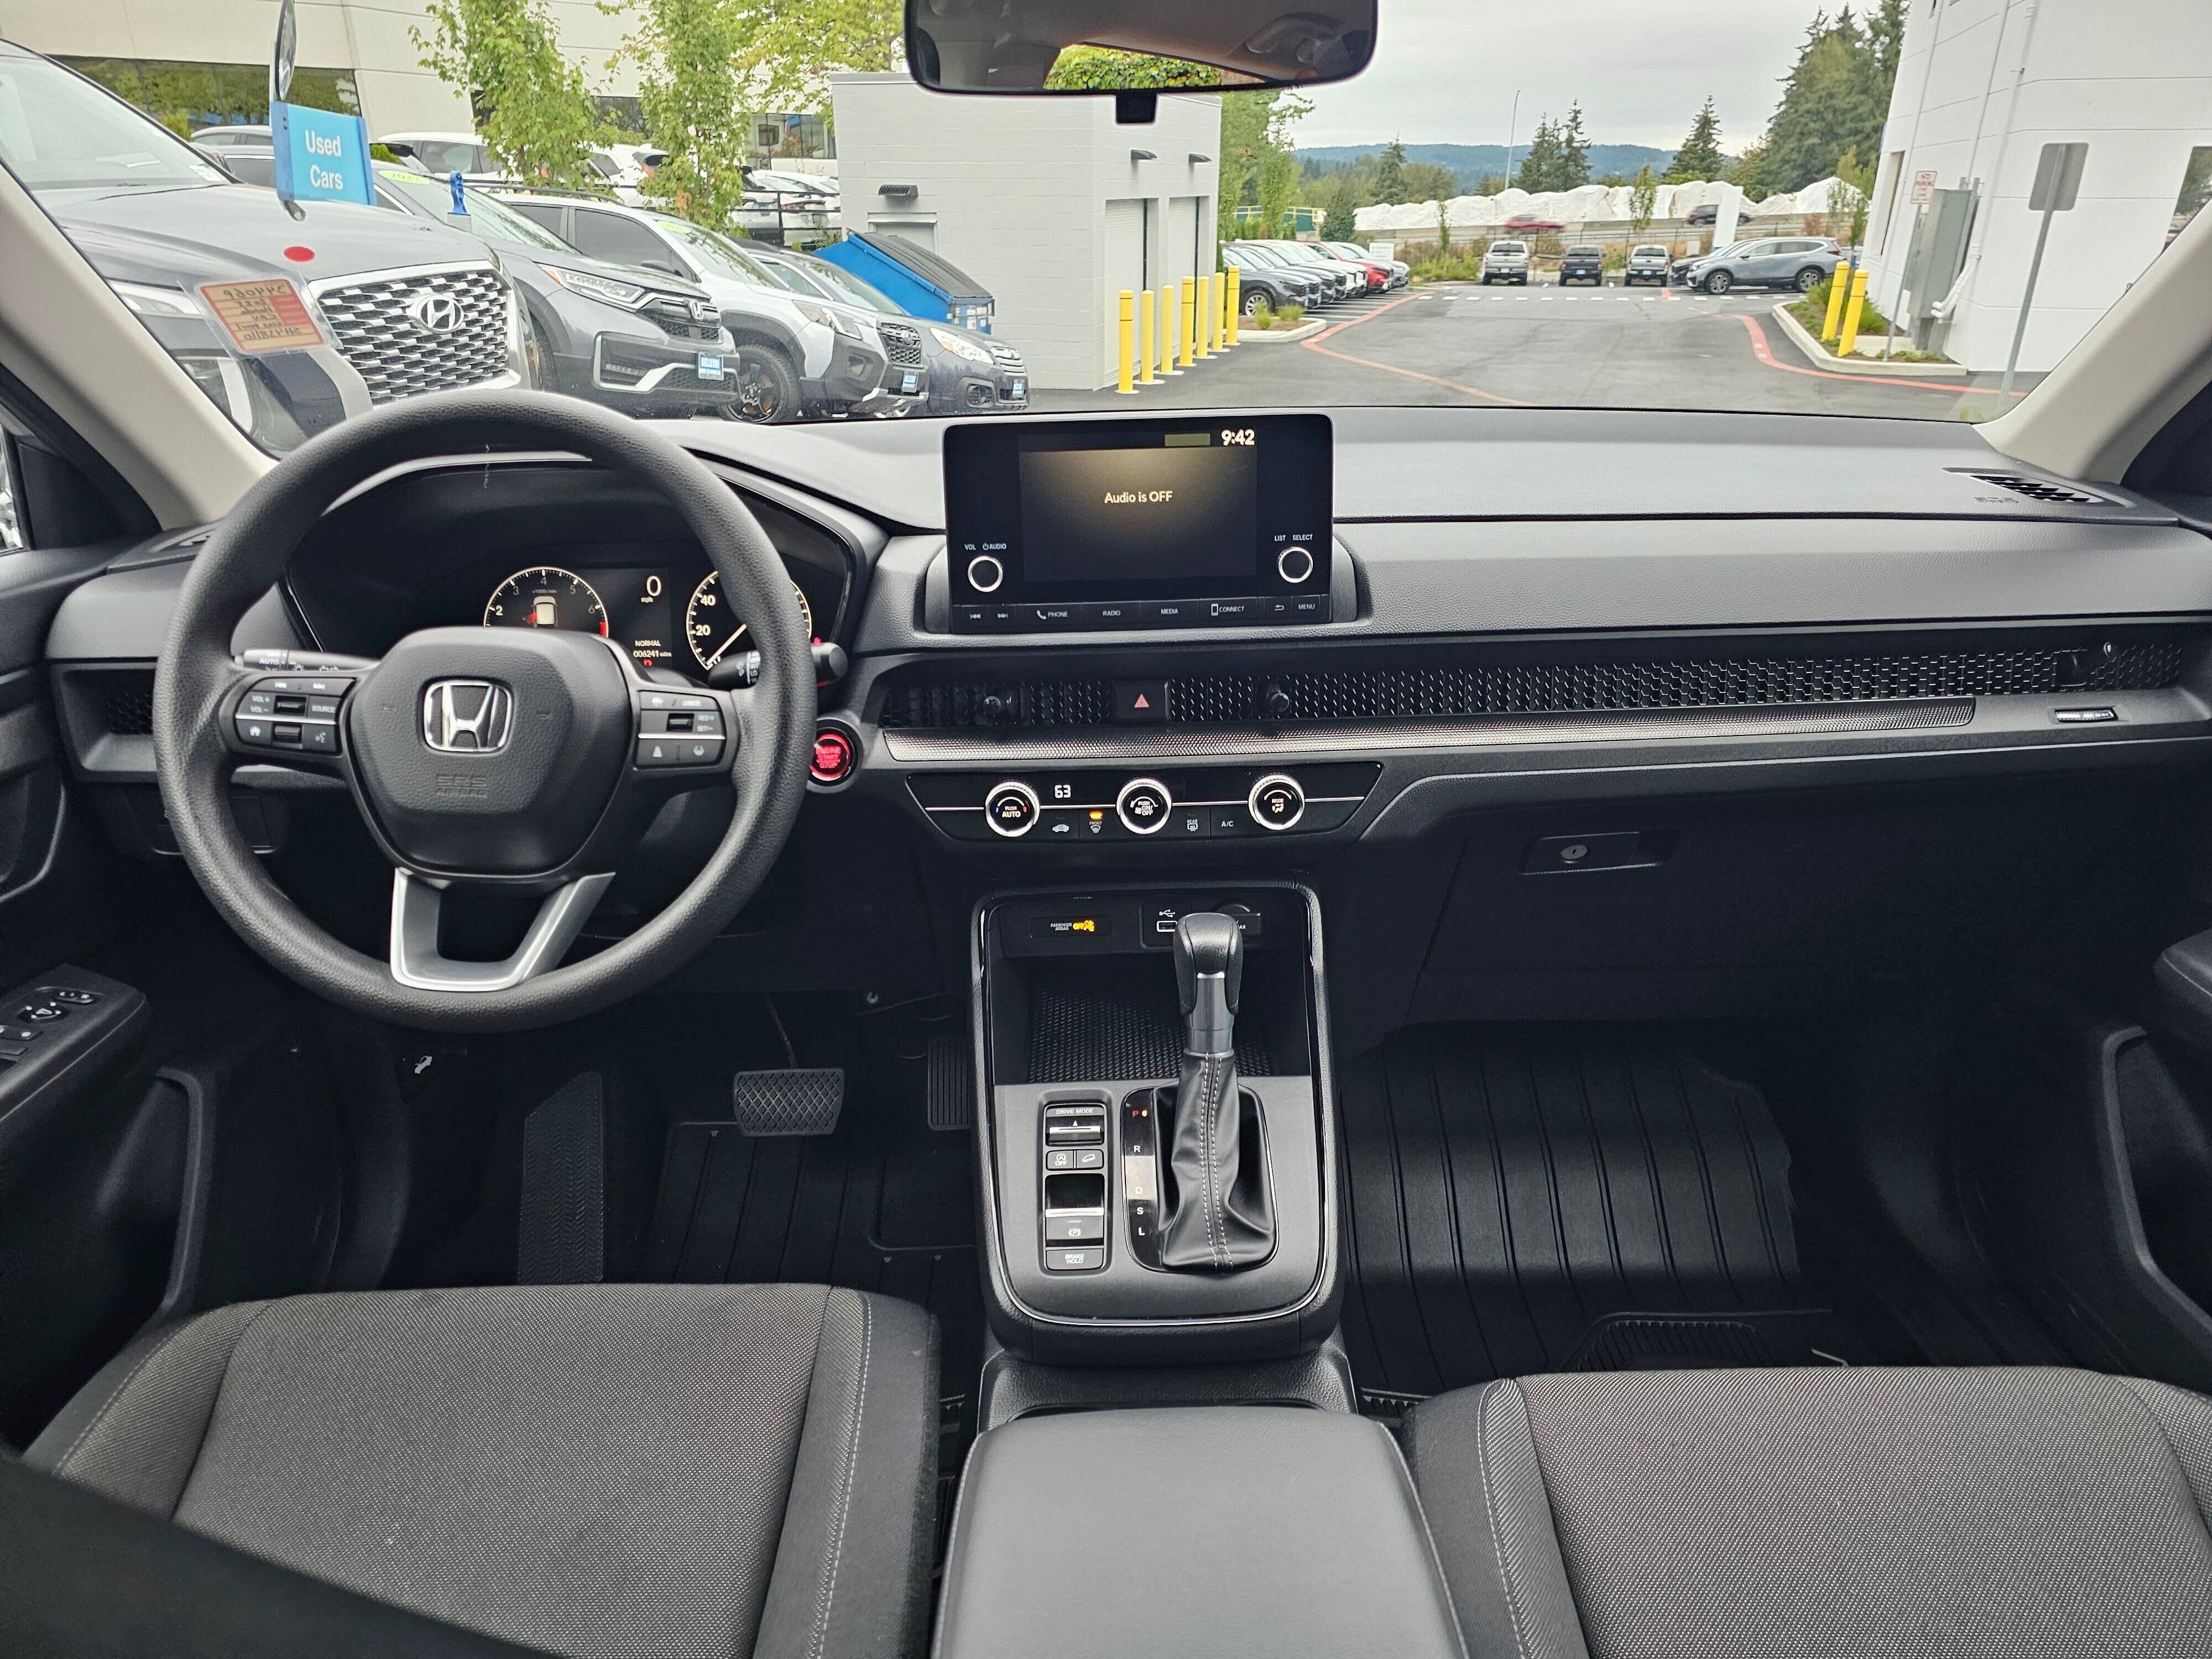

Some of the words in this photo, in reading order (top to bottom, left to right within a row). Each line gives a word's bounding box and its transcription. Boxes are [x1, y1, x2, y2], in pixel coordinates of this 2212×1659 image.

[305, 129, 342, 157] Used
[310, 165, 343, 190] Cars
[1222, 429, 1255, 446] 9:42
[1104, 492, 1136, 503] Audio
[1138, 491, 1147, 503] is
[1149, 491, 1173, 502] OFF
[540, 577, 547, 586] 4
[646, 576, 661, 597] 0
[513, 586, 519, 596] 3
[570, 585, 576, 594] 5
[700, 594, 716, 606] 40
[495, 605, 503, 615] 2
[588, 604, 595, 614] 6
[695, 624, 711, 636] 20
[1055, 784, 1071, 799] 63
[1136, 1207, 1144, 1215] S
[1138, 1227, 1145, 1235] L
